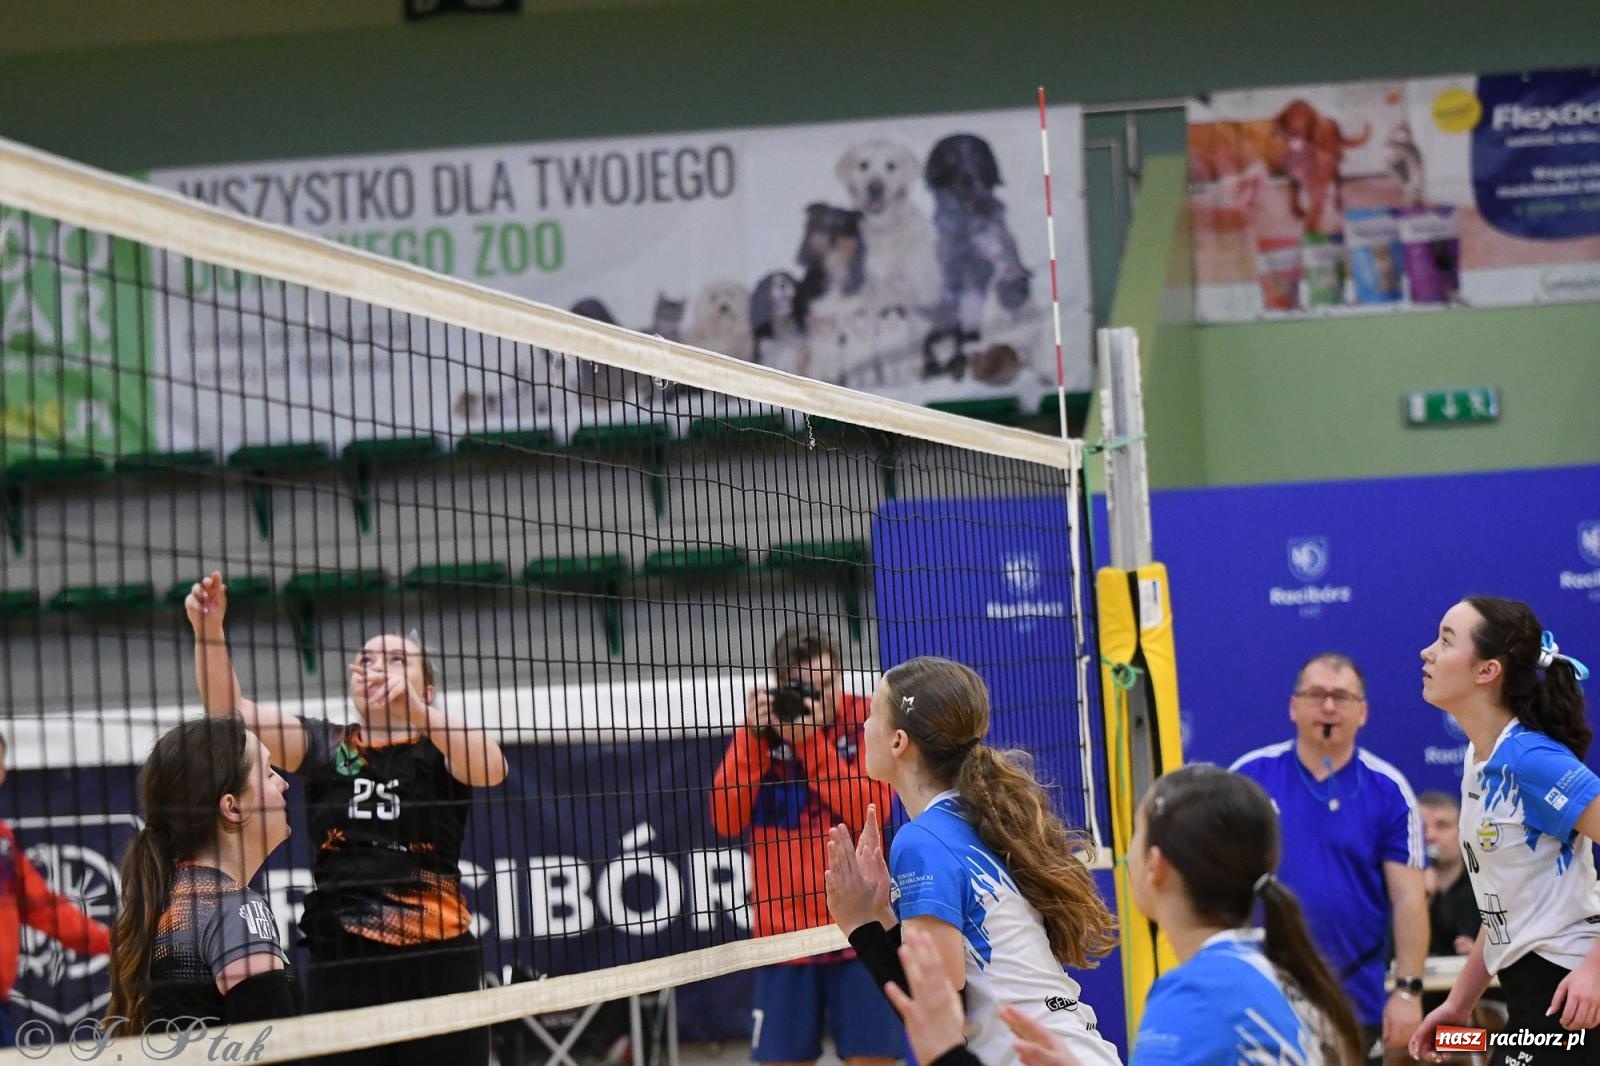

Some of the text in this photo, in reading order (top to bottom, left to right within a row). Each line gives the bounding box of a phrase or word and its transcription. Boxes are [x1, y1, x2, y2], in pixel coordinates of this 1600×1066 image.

[179, 145, 736, 226] WSZYSTKO DLA TWOJEGO
[473, 219, 565, 278] ZOO
[347, 777, 401, 821] 25
